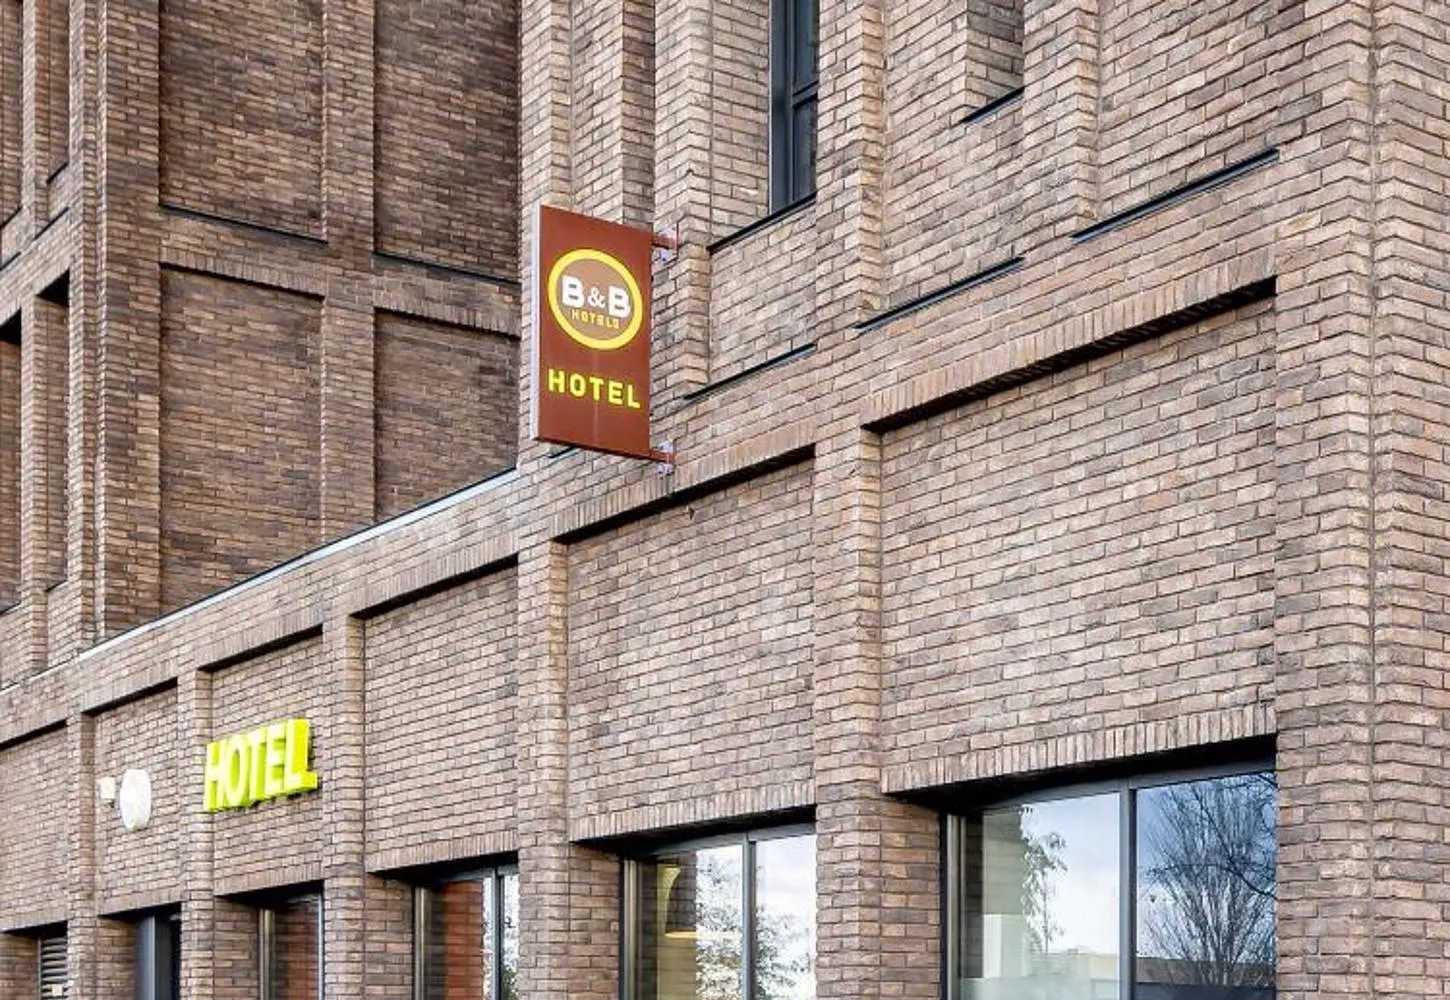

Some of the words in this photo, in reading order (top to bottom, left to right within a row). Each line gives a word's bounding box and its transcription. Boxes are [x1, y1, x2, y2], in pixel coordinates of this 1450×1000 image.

[561, 275, 631, 318] B&B
[571, 308, 620, 330] HOTELS
[548, 369, 641, 409] HOTEL
[203, 718, 318, 812] HOTEL
